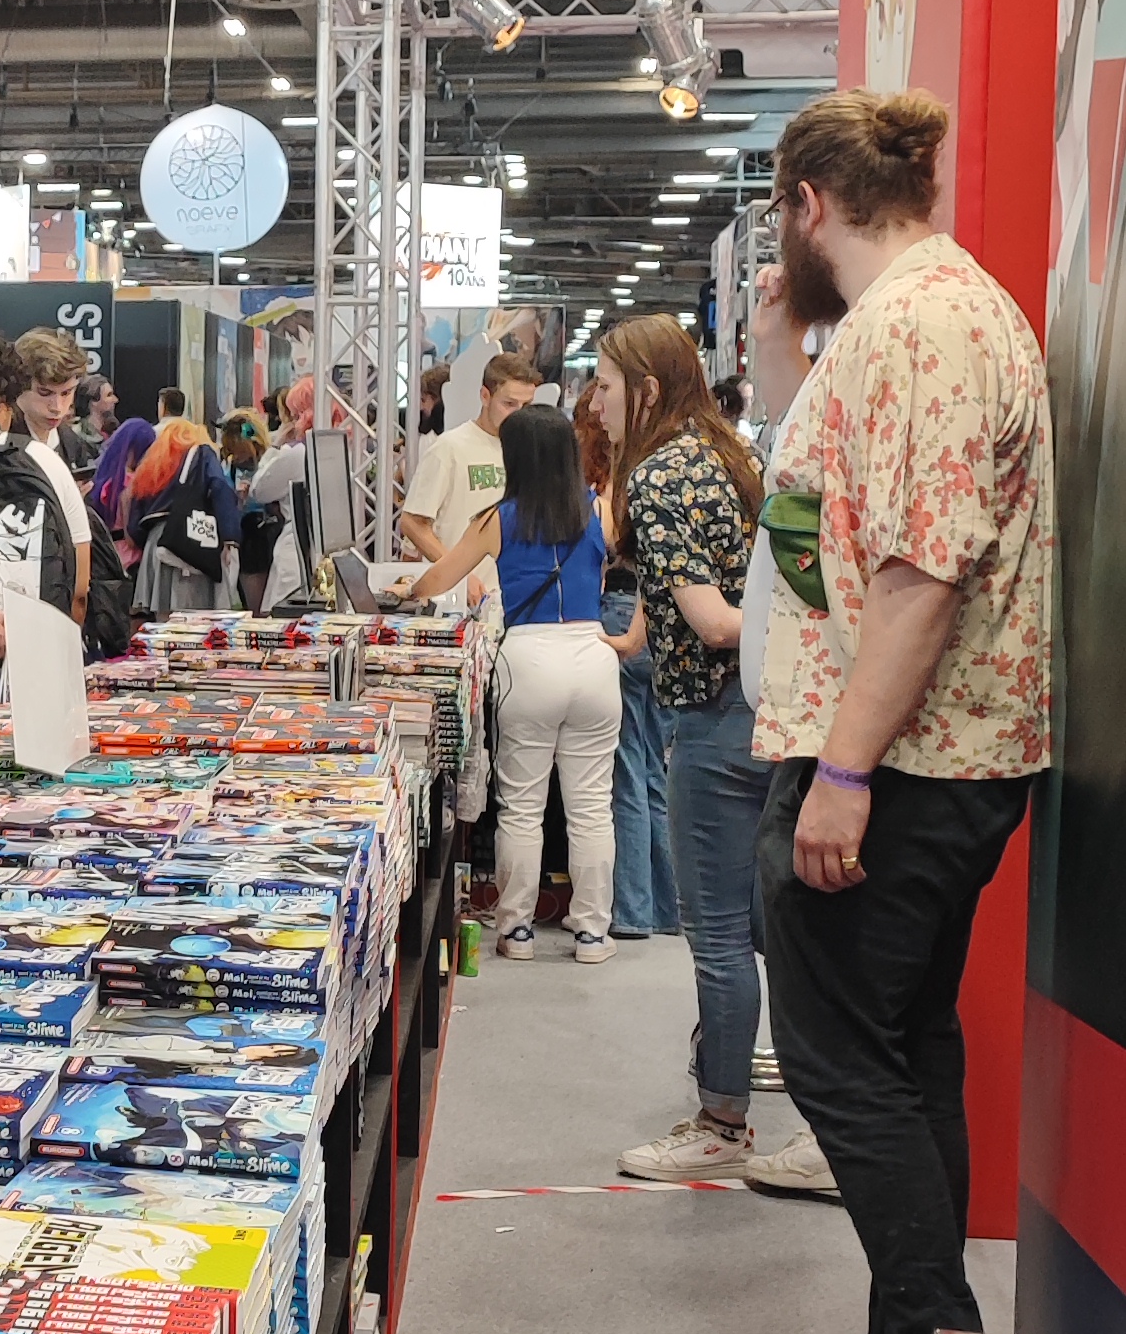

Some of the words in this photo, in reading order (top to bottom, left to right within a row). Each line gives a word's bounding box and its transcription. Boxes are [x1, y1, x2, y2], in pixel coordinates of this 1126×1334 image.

[176, 205, 239, 223] noeve
[447, 268, 465, 286] 10
[271, 973, 311, 990] Slime
[281, 989, 319, 1005] Slime
[26, 1021, 66, 1037] Slime
[246, 1157, 292, 1175] Slime
